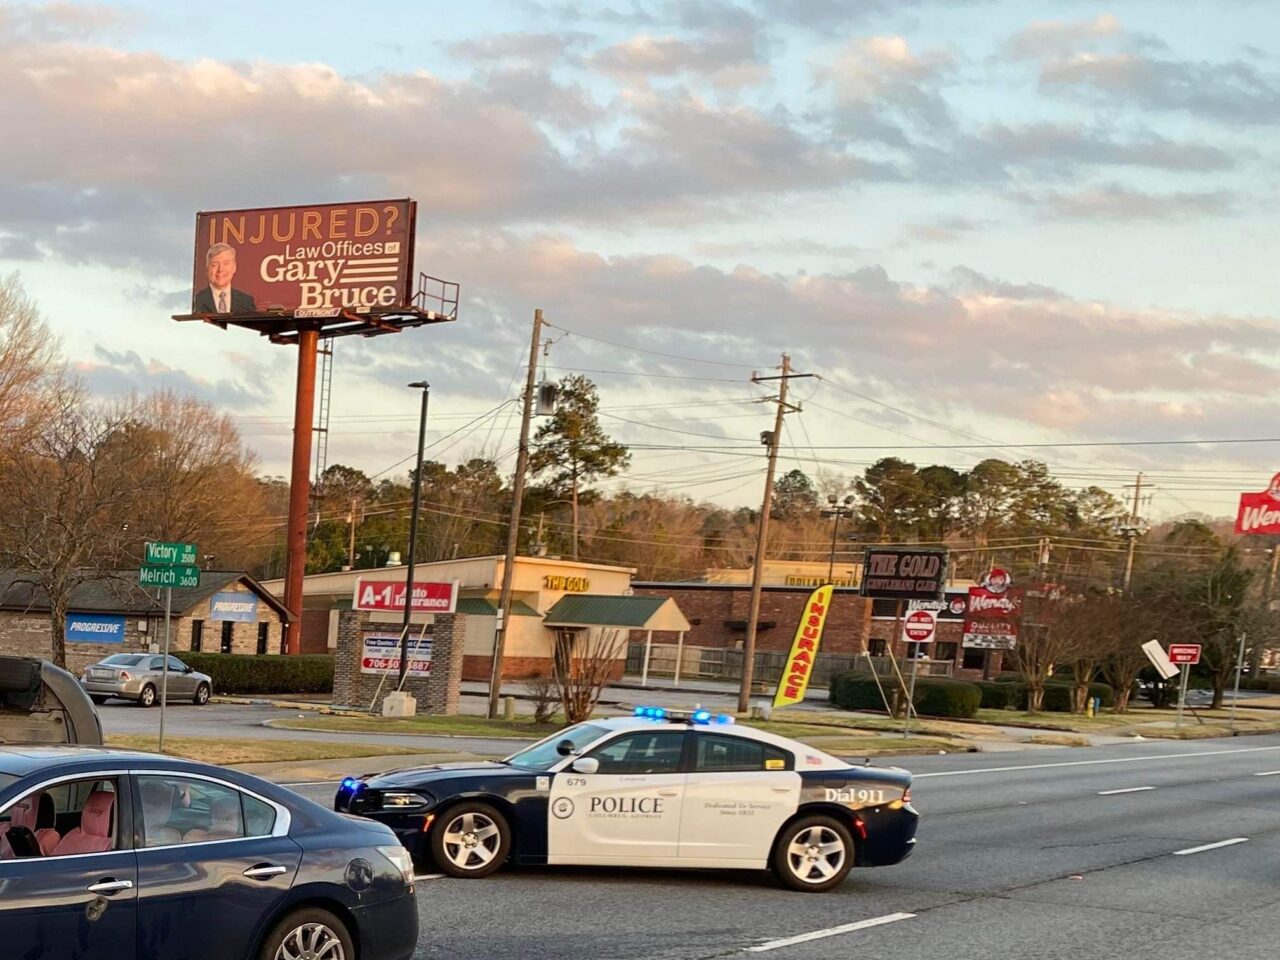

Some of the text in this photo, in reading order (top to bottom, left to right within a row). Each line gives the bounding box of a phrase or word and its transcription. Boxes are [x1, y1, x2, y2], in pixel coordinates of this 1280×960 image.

[208, 206, 399, 246] INJURED?
[285, 244, 319, 260] Law
[322, 241, 383, 258] Offices
[260, 254, 345, 286] Gary
[299, 282, 397, 310] Bruce
[149, 543, 177, 562] Victory
[181, 554, 195, 563] 3500
[869, 554, 940, 577] THE GOLD
[140, 568, 175, 583] Melrich
[180, 576, 197, 586] 3600
[360, 586, 392, 606] A-1
[394, 595, 449, 607] Inurance
[213, 602, 255, 613] PROGRESSIVE
[908, 599, 949, 613] Wendy's
[70, 622, 120, 633] PROGRESSIVE
[784, 592, 824, 699] INSURANCE
[567, 778, 586, 786] 679
[825, 788, 884, 803] Dial 911
[590, 797, 664, 813] POLICE
